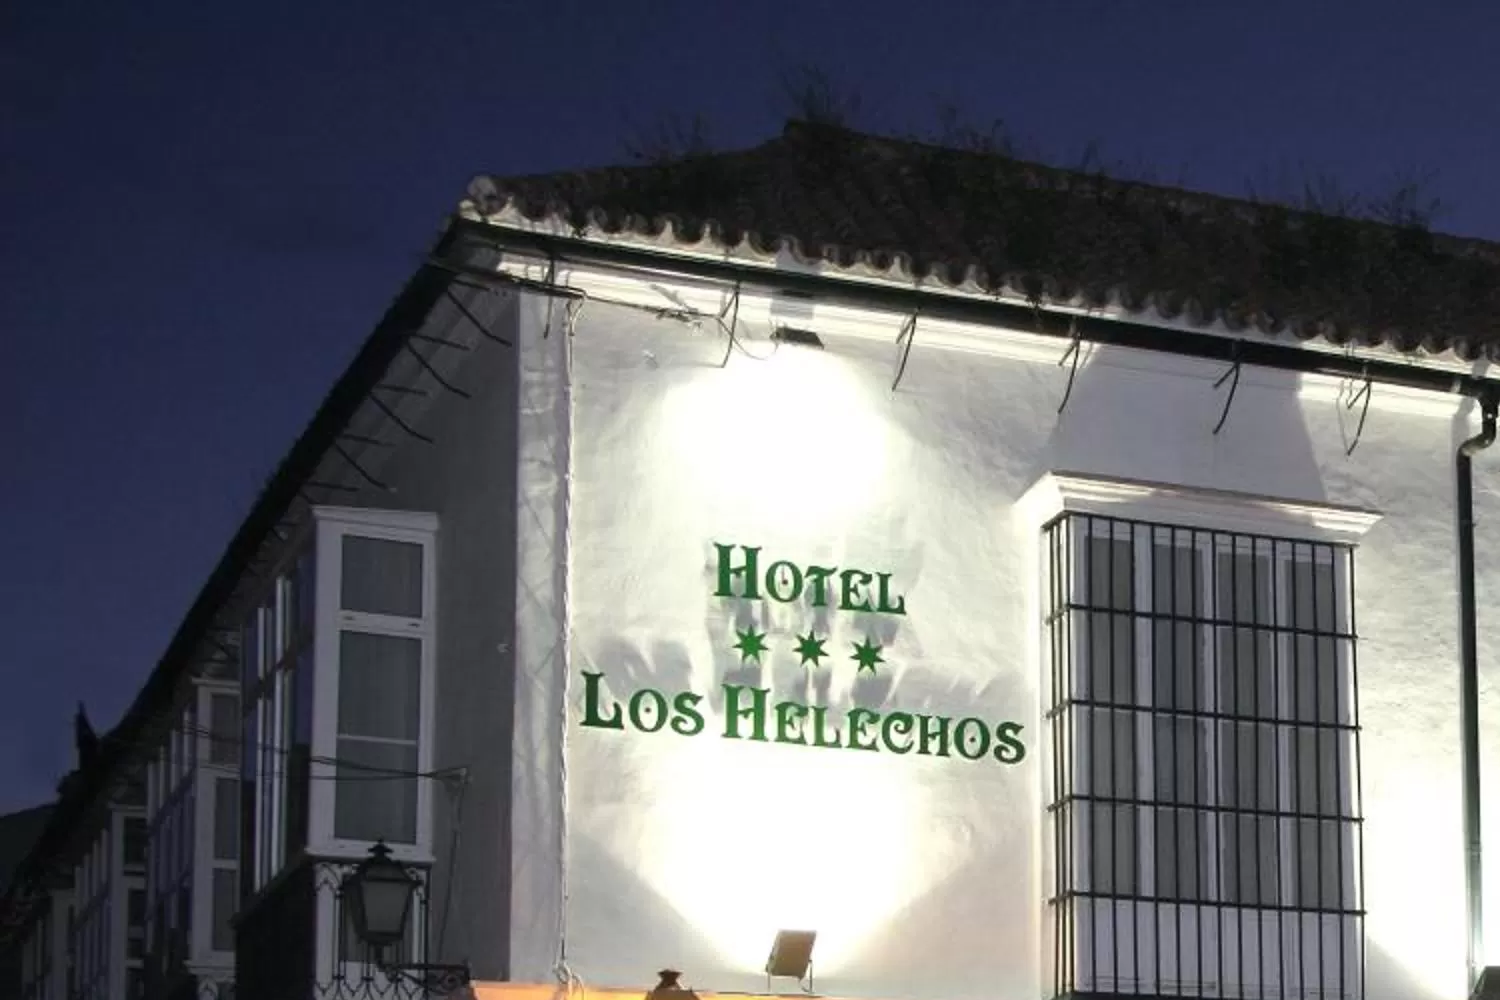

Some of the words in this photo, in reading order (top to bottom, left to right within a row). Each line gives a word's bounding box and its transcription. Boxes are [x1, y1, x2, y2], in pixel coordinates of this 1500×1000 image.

[713, 542, 906, 615] HOTEL
[579, 671, 705, 737] LOS
[722, 683, 1027, 764] HELECHOS
